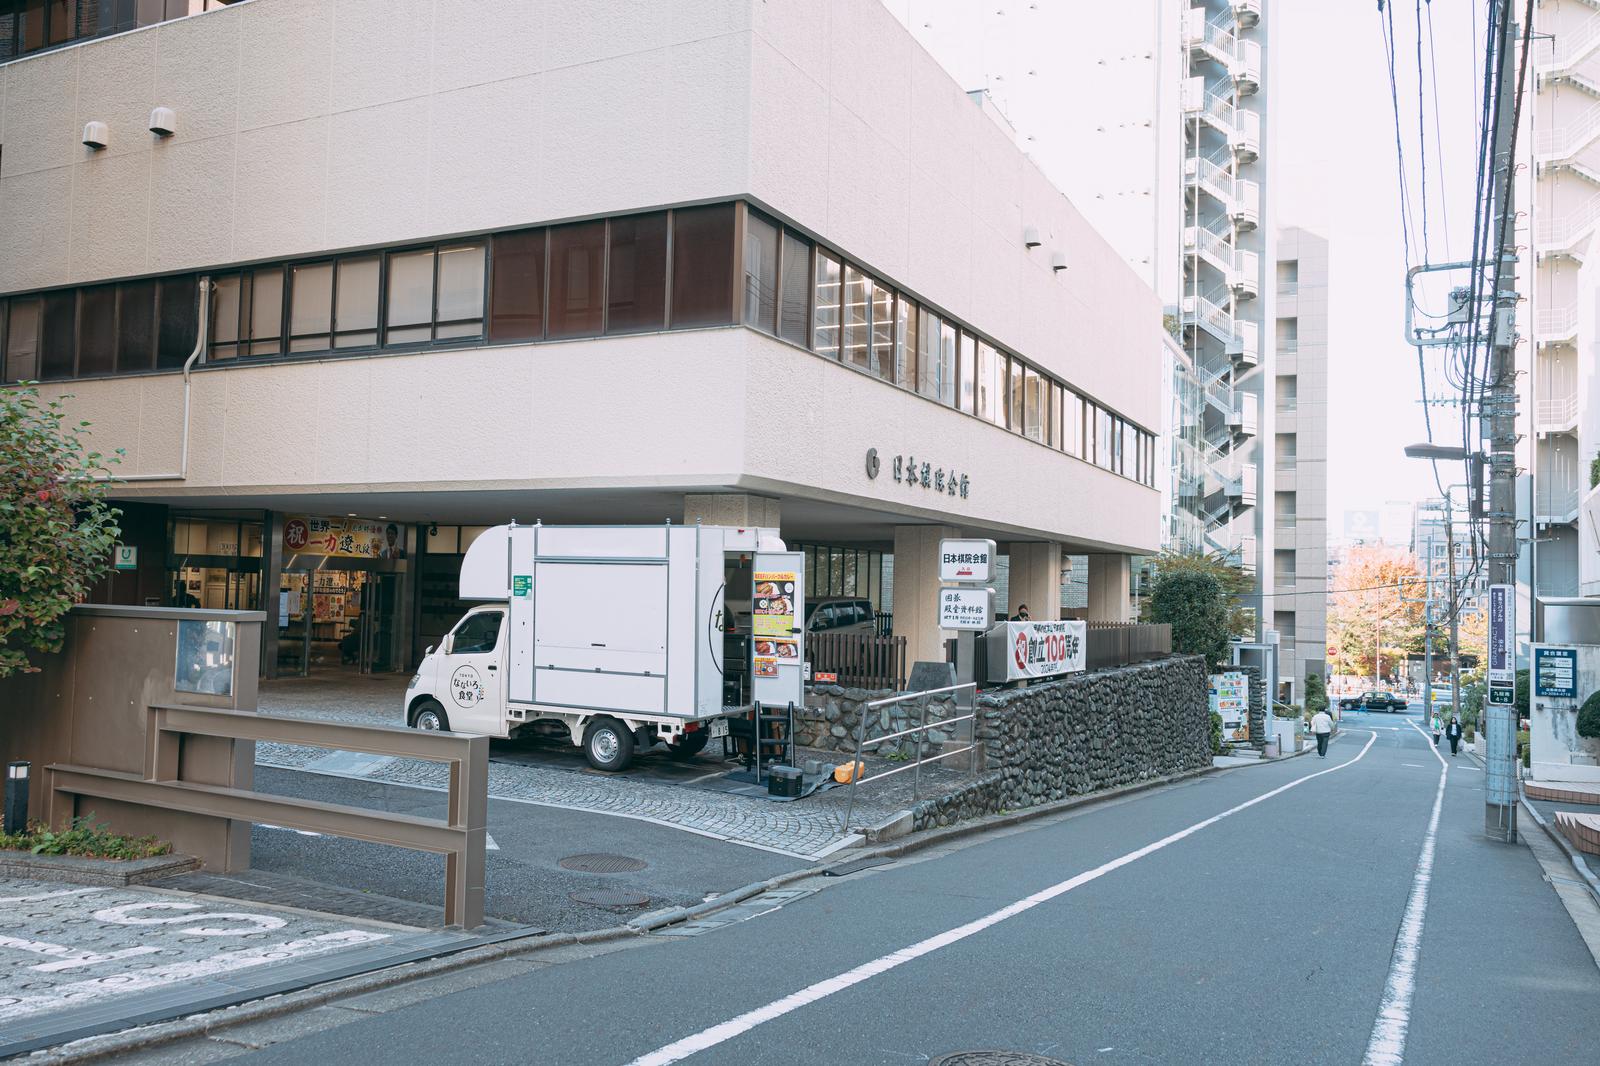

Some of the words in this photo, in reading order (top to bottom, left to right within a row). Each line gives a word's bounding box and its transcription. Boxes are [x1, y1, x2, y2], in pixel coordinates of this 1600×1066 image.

[893, 455, 970, 499] 日本棋院会館
[287, 523, 305, 545] 祝
[943, 553, 988, 564] 日本棋院会館
[1028, 634, 1080, 664] 創立100周年
[453, 679, 479, 690] なないろ
